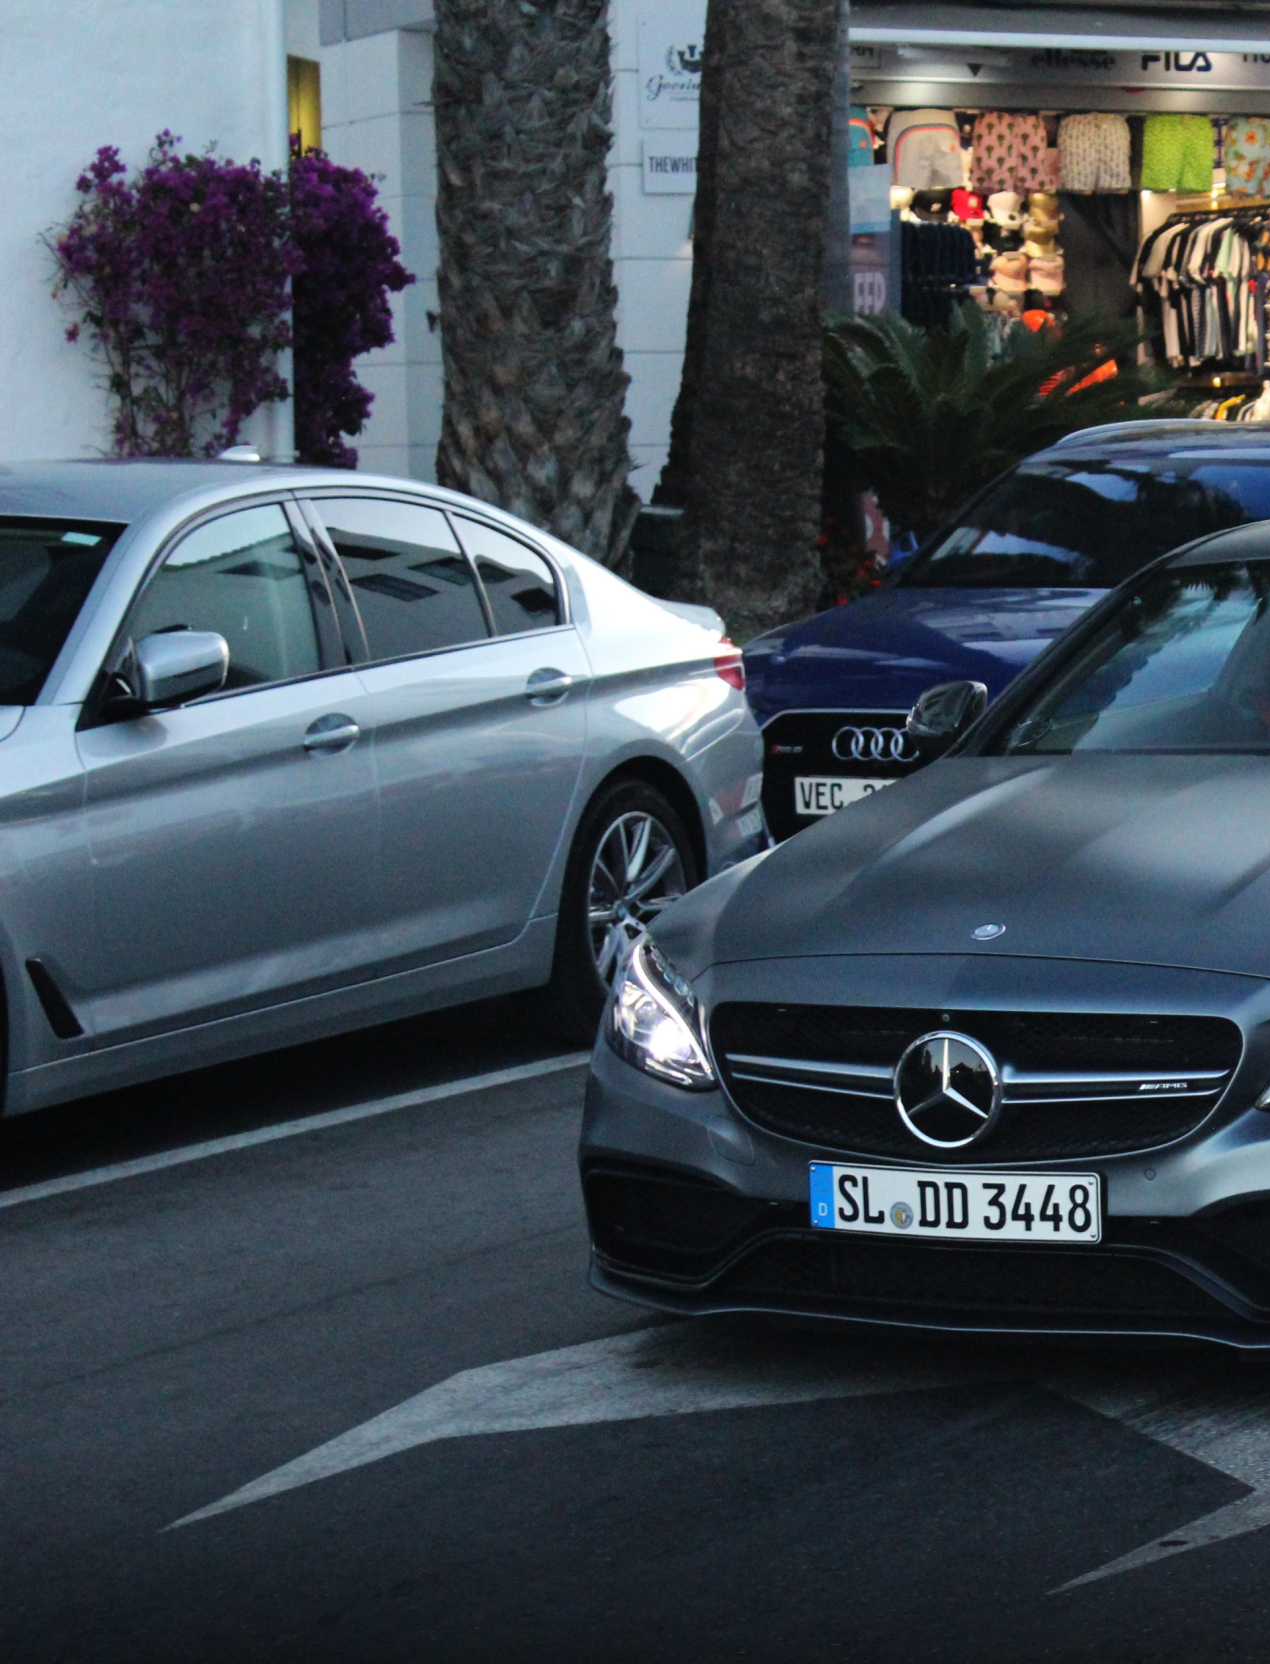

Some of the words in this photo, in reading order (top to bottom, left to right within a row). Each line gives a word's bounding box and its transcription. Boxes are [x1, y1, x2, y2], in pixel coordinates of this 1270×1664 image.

[1141, 51, 1212, 72] FILA
[800, 781, 844, 810] VEC
[1155, 1082, 1188, 1090] AMG
[818, 1203, 828, 1216] D
[838, 1174, 885, 1224] SL
[917, 1180, 968, 1229] DD
[982, 1183, 1092, 1233] 3448
